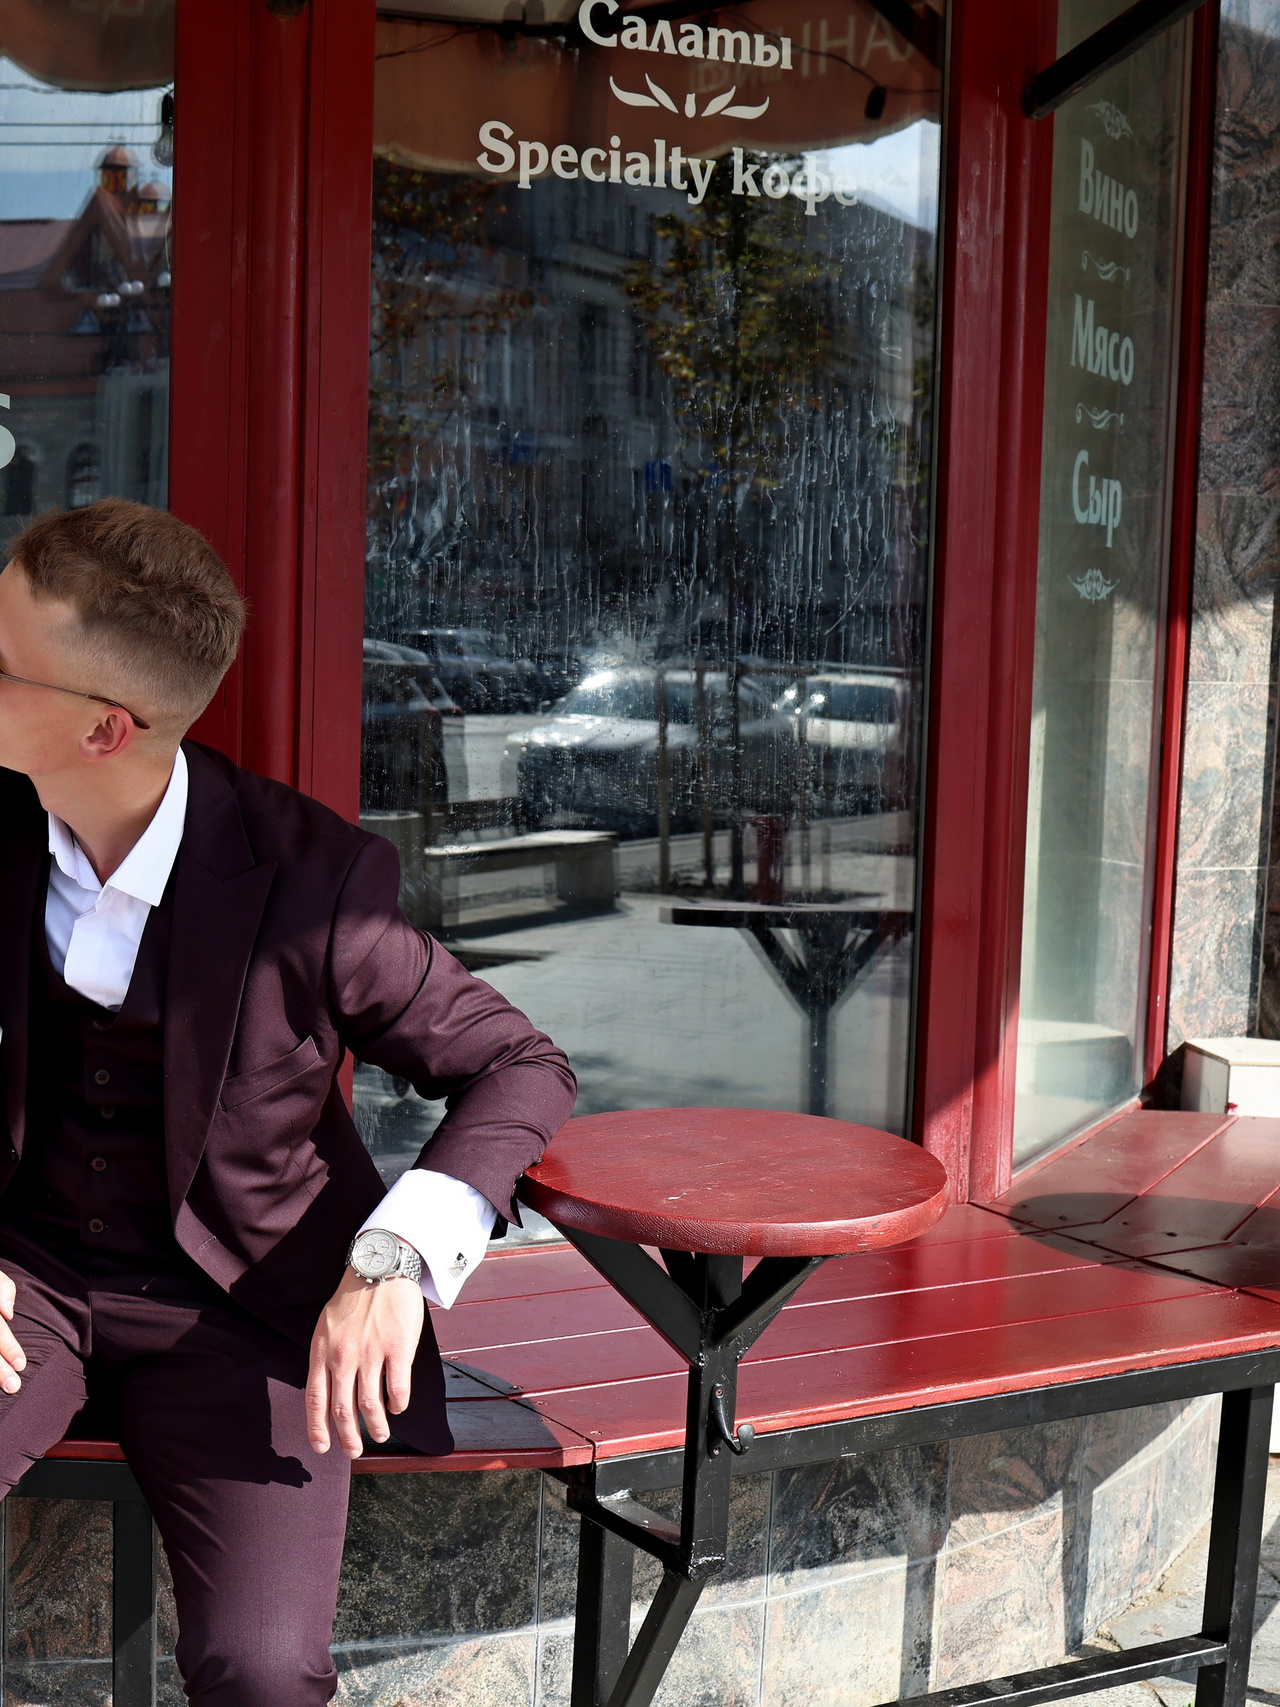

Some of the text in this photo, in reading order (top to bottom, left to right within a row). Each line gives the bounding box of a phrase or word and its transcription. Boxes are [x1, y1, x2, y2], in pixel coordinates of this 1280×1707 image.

[578, 0, 793, 70] Салаты
[476, 120, 858, 216] Specialty кофе
[1078, 137, 1138, 239] Вино
[1070, 293, 1135, 386] Мясо
[1071, 449, 1121, 548] Сыр
